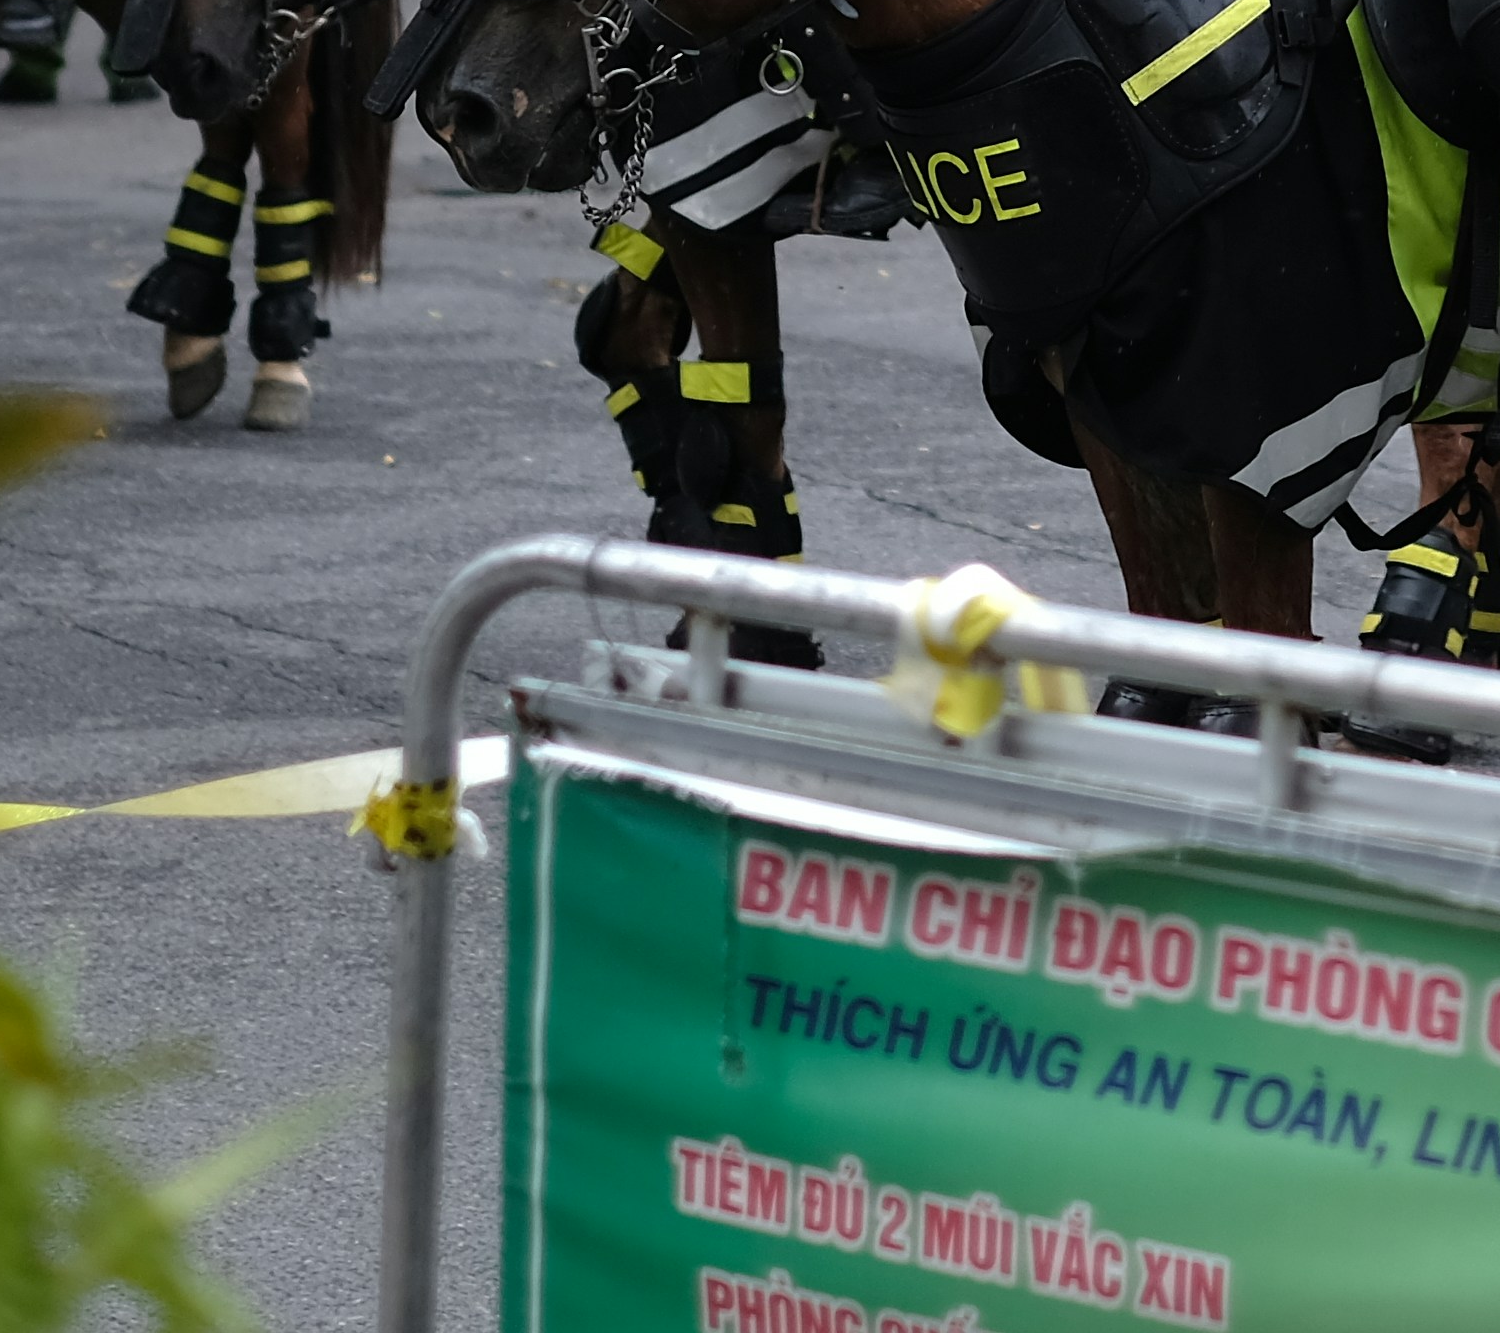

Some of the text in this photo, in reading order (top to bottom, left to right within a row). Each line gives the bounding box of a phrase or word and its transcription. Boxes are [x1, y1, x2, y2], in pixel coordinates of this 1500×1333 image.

[737, 845, 894, 939] BAN
[908, 871, 1034, 964] CHỈ
[1049, 902, 1199, 998] ĐẠO
[1215, 933, 1466, 1046] PHÒNG
[745, 973, 931, 1060] THÍCH
[948, 1003, 1083, 1090] ỨNG
[1095, 1048, 1191, 1111] AN
[1209, 1065, 1388, 1166] TOÀN,
[677, 1141, 1227, 1324] TIÊM ĐỦ 2 MŨI VẮC XIN
